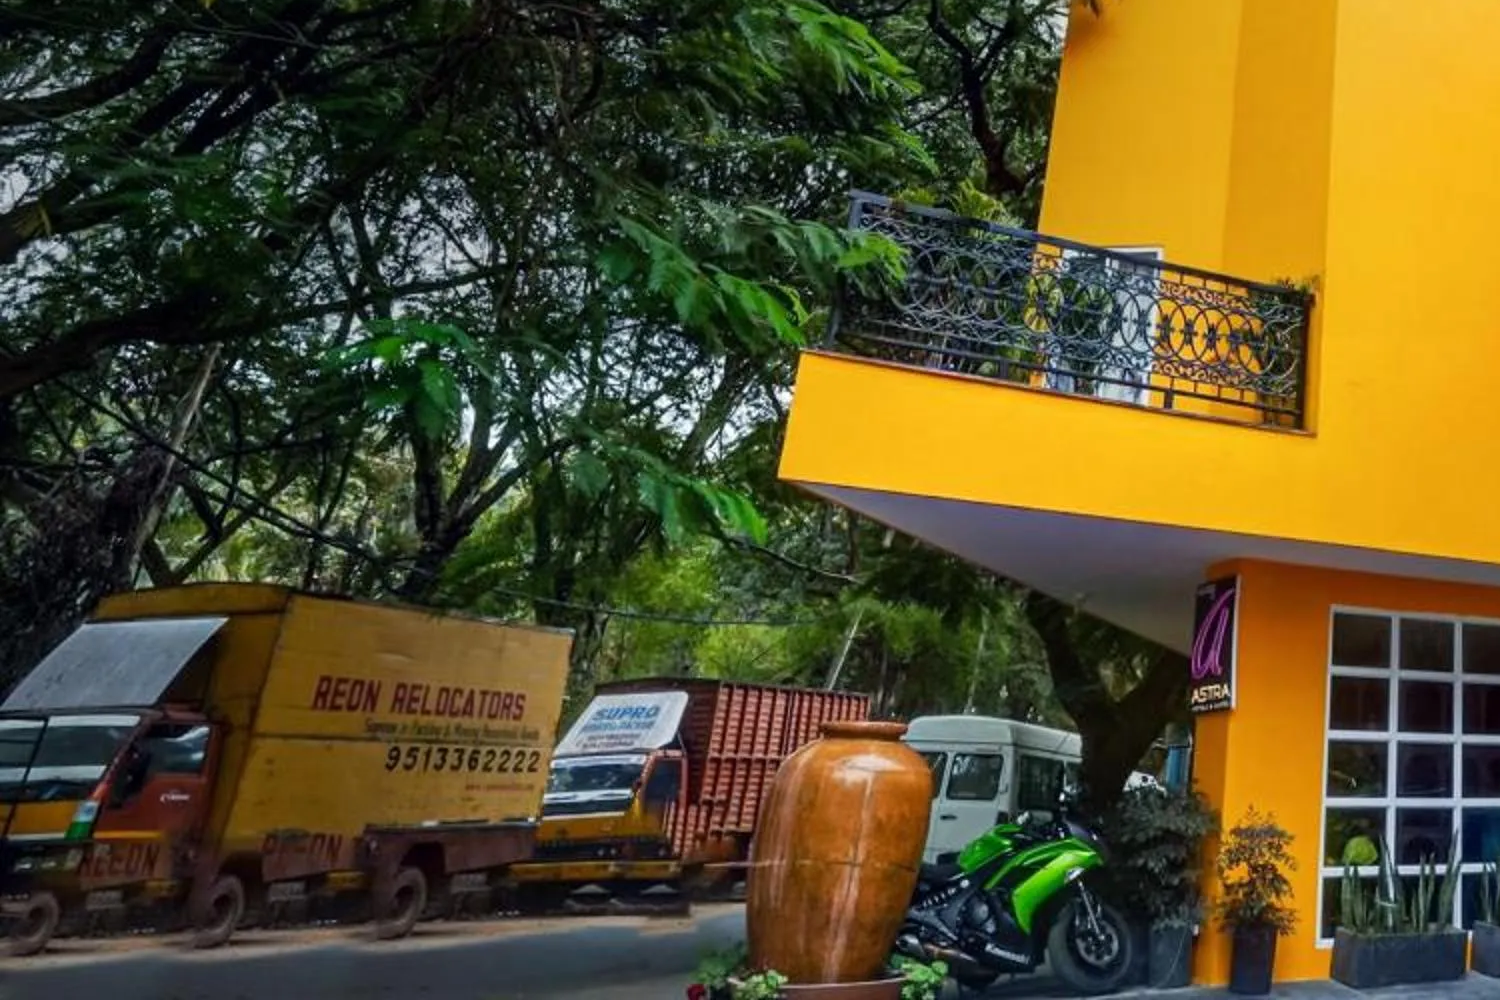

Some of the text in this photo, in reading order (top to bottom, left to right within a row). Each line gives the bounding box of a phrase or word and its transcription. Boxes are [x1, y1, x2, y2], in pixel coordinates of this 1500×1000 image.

[312, 675, 527, 721] REON RELOCATORS
[1191, 683, 1231, 704] ASTRA
[595, 704, 660, 720] SUPRO
[384, 746, 541, 775] 9513362222
